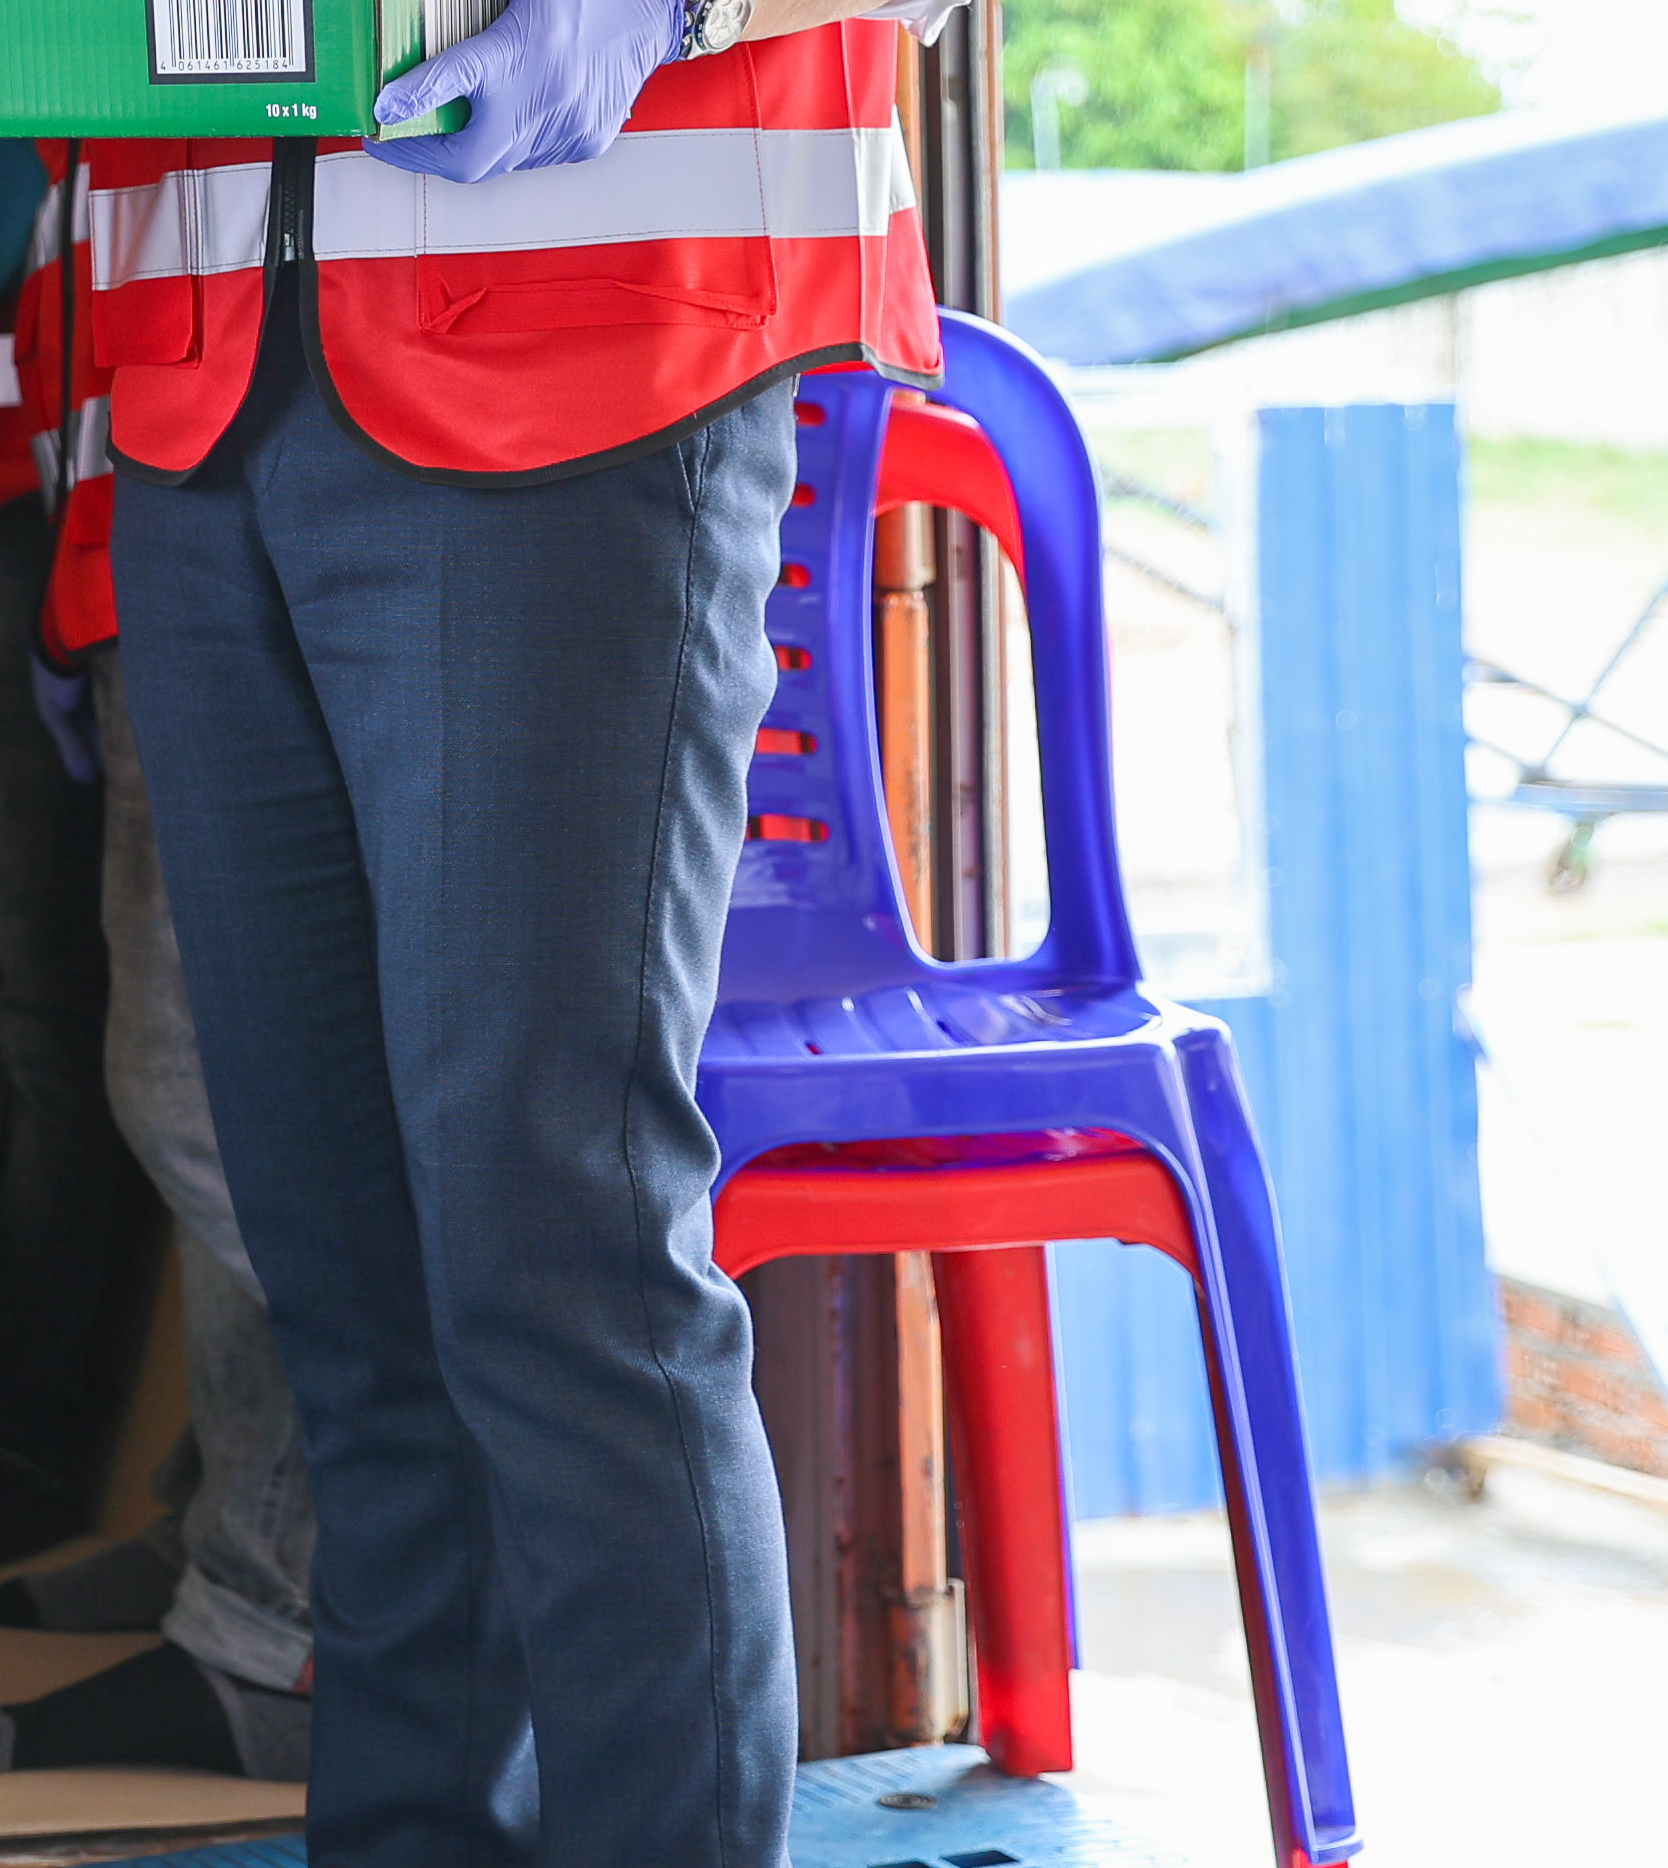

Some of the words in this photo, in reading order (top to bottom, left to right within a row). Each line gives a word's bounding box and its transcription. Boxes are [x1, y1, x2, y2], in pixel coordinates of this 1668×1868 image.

[160, 62, 166, 71] 4
[179, 60, 229, 71] 061461
[236, 59, 288, 71] 625184
[266, 104, 280, 117] 10
[282, 107, 290, 117] x
[292, 103, 298, 117] 1
[302, 102, 317, 120] kg
